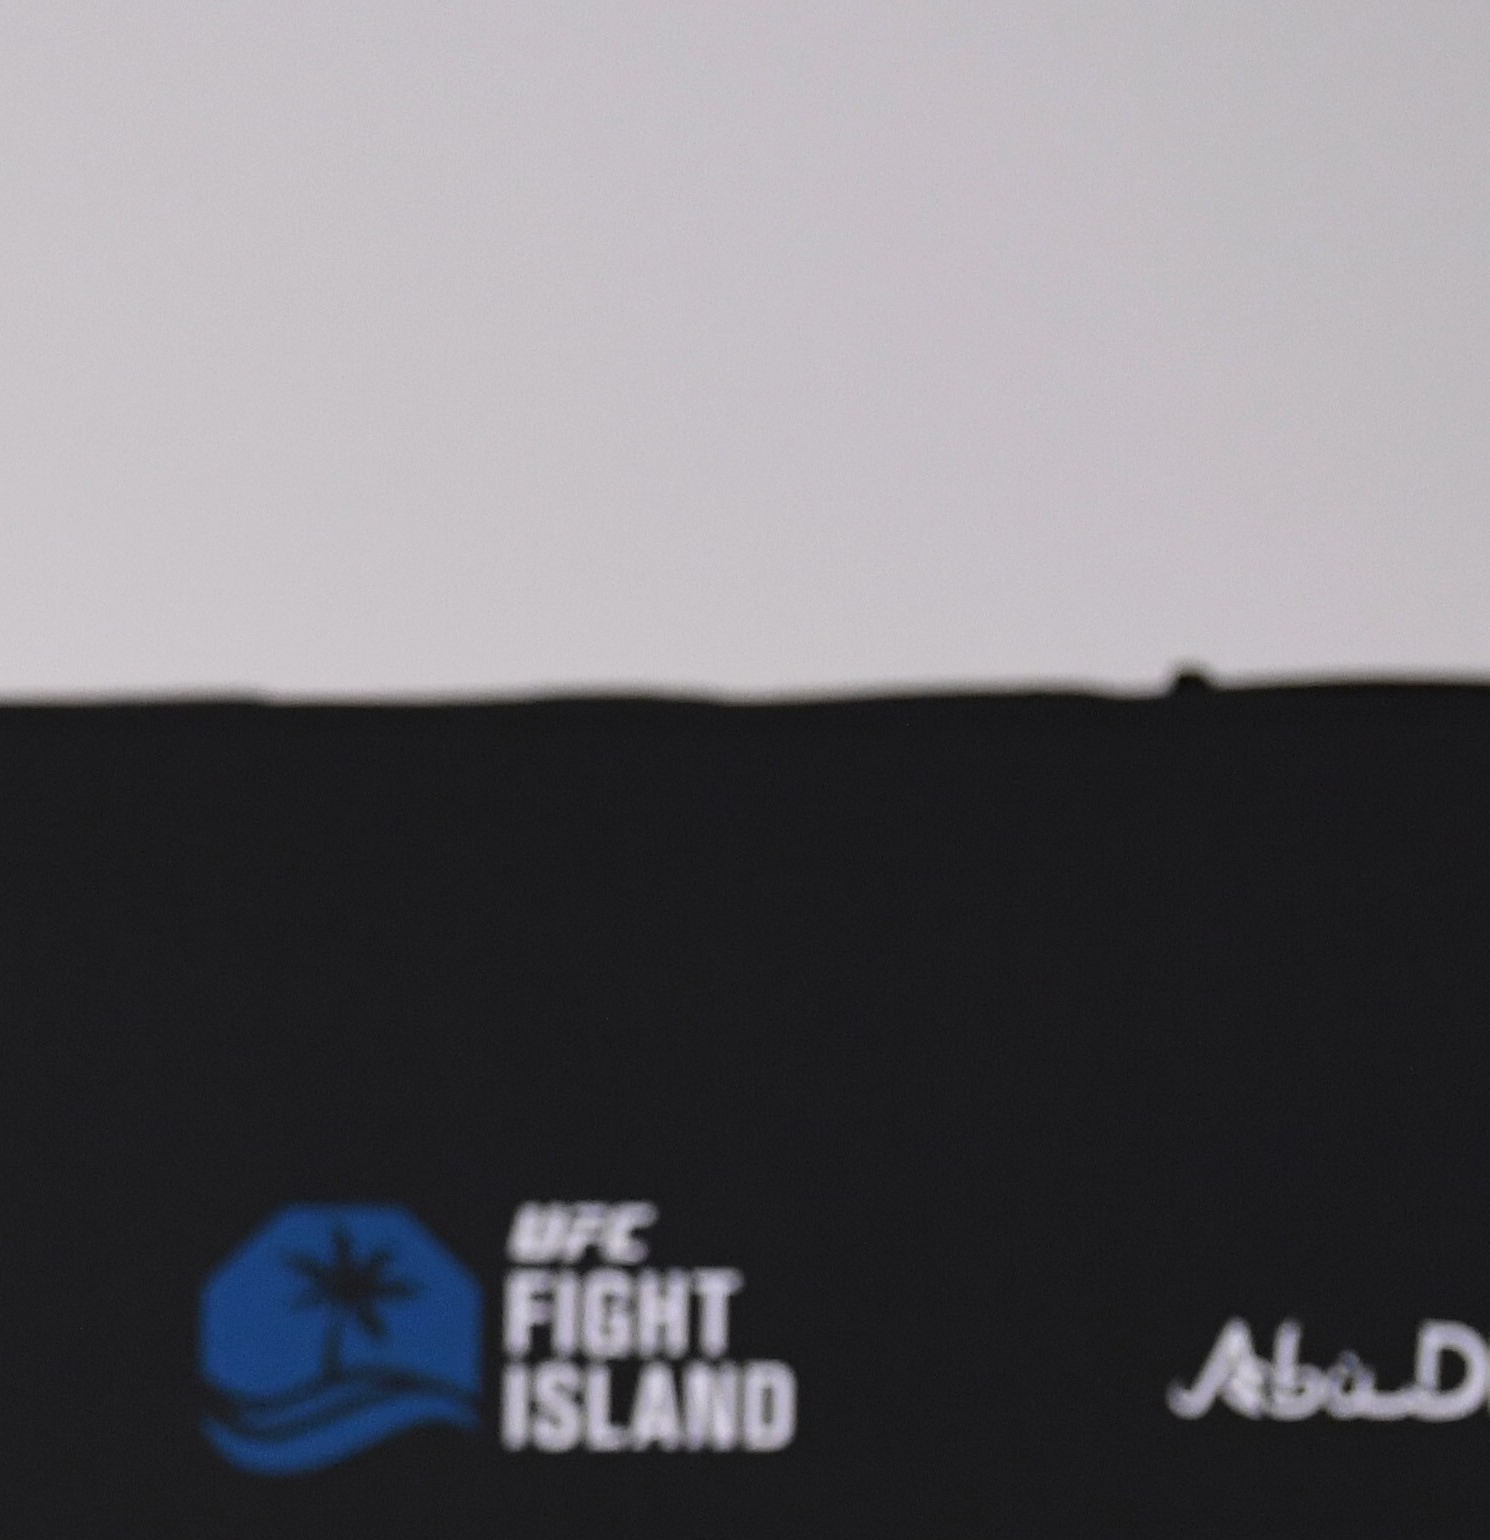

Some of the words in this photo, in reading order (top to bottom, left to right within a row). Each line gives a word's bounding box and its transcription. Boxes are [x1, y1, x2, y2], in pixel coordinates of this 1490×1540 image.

[506, 1201, 658, 1265] UFC
[503, 1267, 743, 1358] FIGHT
[501, 1360, 797, 1453] ISLAND
